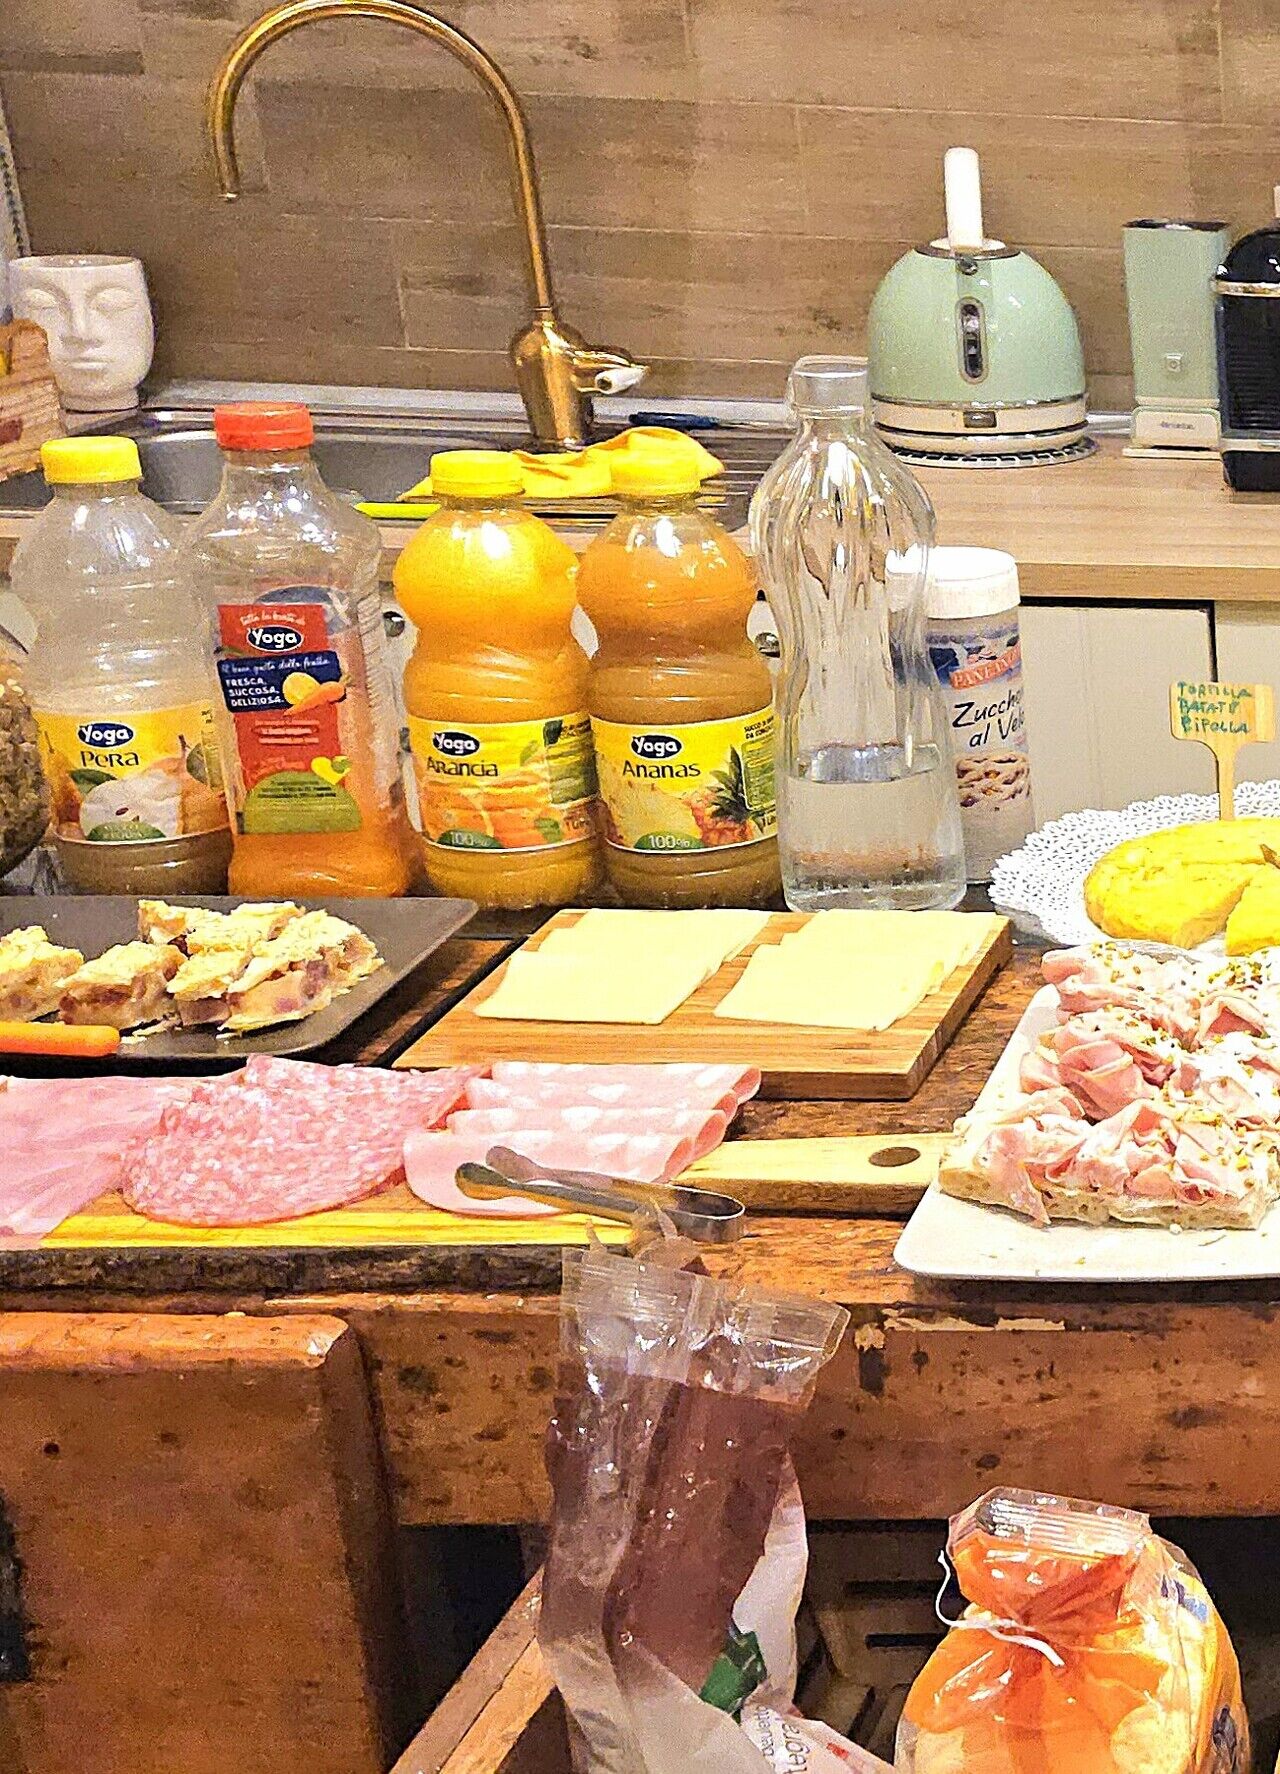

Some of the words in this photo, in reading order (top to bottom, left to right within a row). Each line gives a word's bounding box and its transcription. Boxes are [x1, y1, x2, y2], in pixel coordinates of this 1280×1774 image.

[251, 628, 297, 648] Yoga
[81, 725, 130, 746] Yoga
[435, 733, 477, 754] Yoga
[969, 722, 991, 747] al
[633, 736, 678, 757] Yoga
[623, 760, 701, 779] Ananas
[649, 835, 690, 849] 100%
